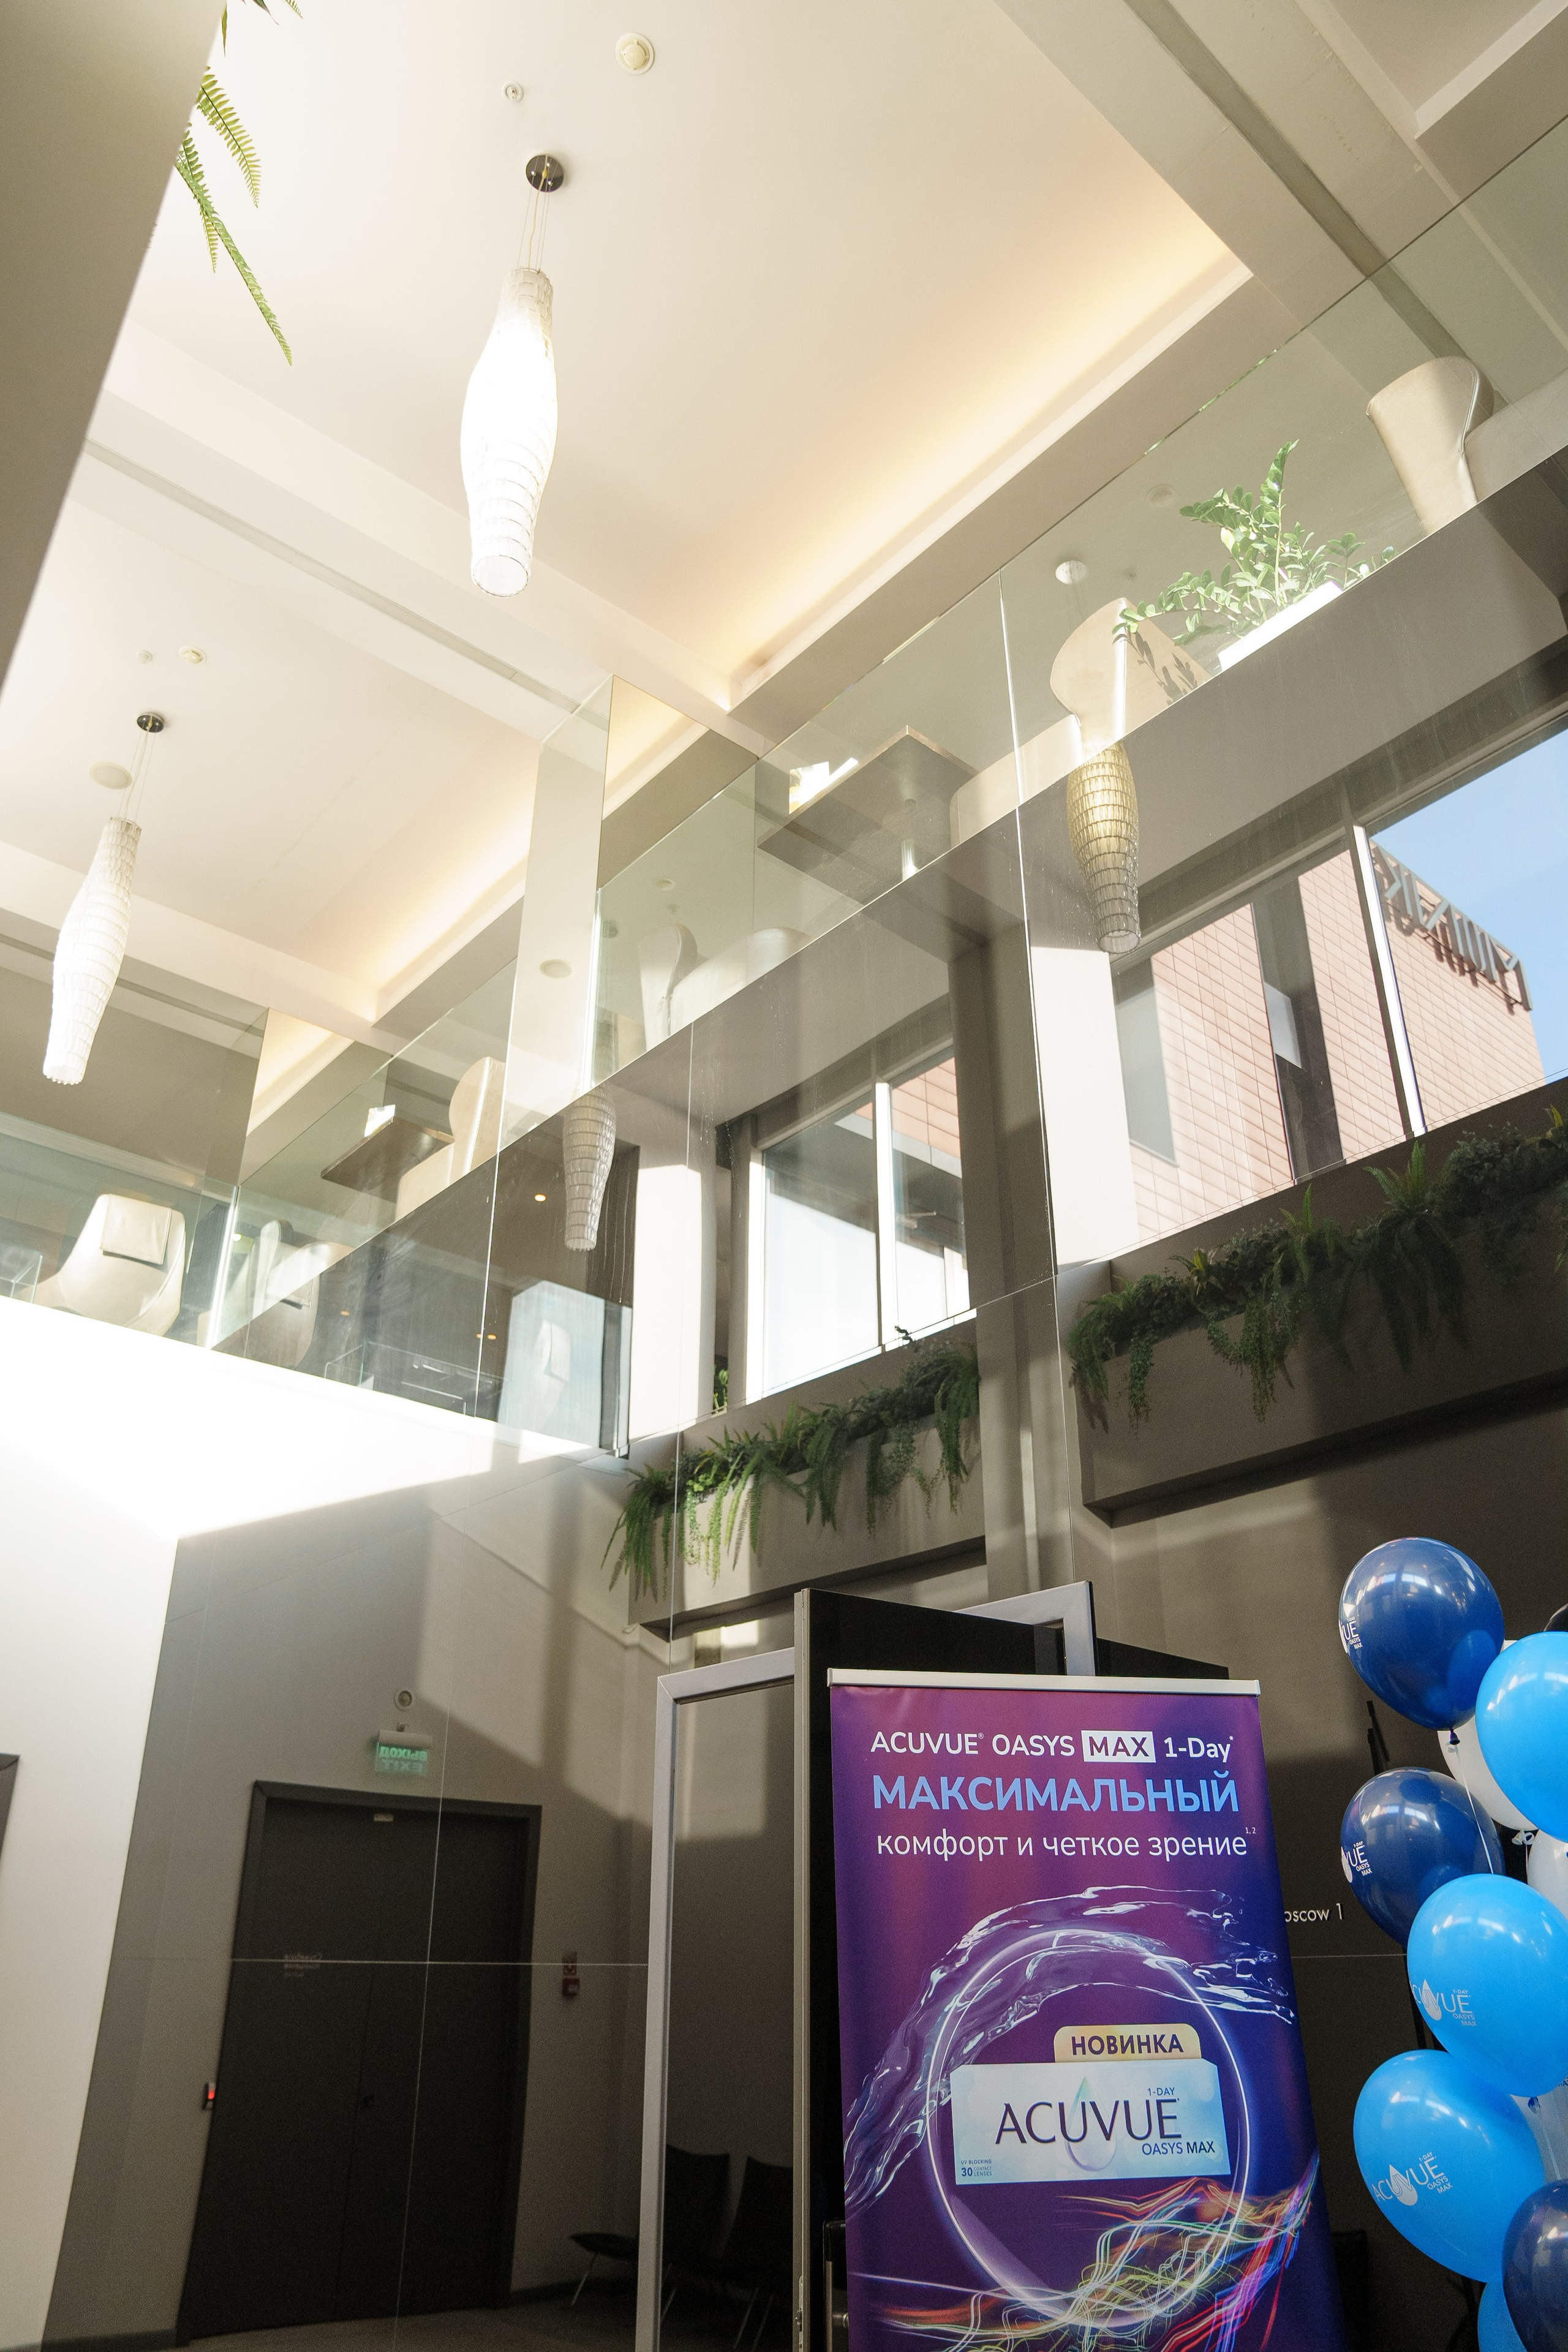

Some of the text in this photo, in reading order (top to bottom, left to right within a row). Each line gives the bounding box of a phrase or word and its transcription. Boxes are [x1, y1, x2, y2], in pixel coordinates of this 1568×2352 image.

[992, 1733, 1075, 1757] OASYS
[1088, 1736, 1149, 1757] MAX
[873, 1770, 1239, 1812] МАКСИМАЛЬНЫЙ
[877, 1828, 1008, 1861] комфорт
[1017, 1837, 1033, 1856] и
[1042, 1836, 1140, 1856] четкое
[1355, 1862, 1370, 1872] OASYS
[1361, 1868, 1373, 1876] MAX
[1284, 1903, 1342, 1922] oscow 1
[1071, 2034, 1184, 2056] НОВИНКА
[1147, 2087, 1175, 2096] 1-DAY
[994, 2098, 1182, 2144] ACUVUE
[1142, 2141, 1216, 2155] OASYS MAX
[1419, 2151, 1433, 2162] 1-DAY
[961, 2167, 973, 2177] 30
[1371, 2156, 1445, 2203] ACUVUE
[1427, 2175, 1449, 2190] OASYS
[1436, 2182, 1453, 2194] MAX
